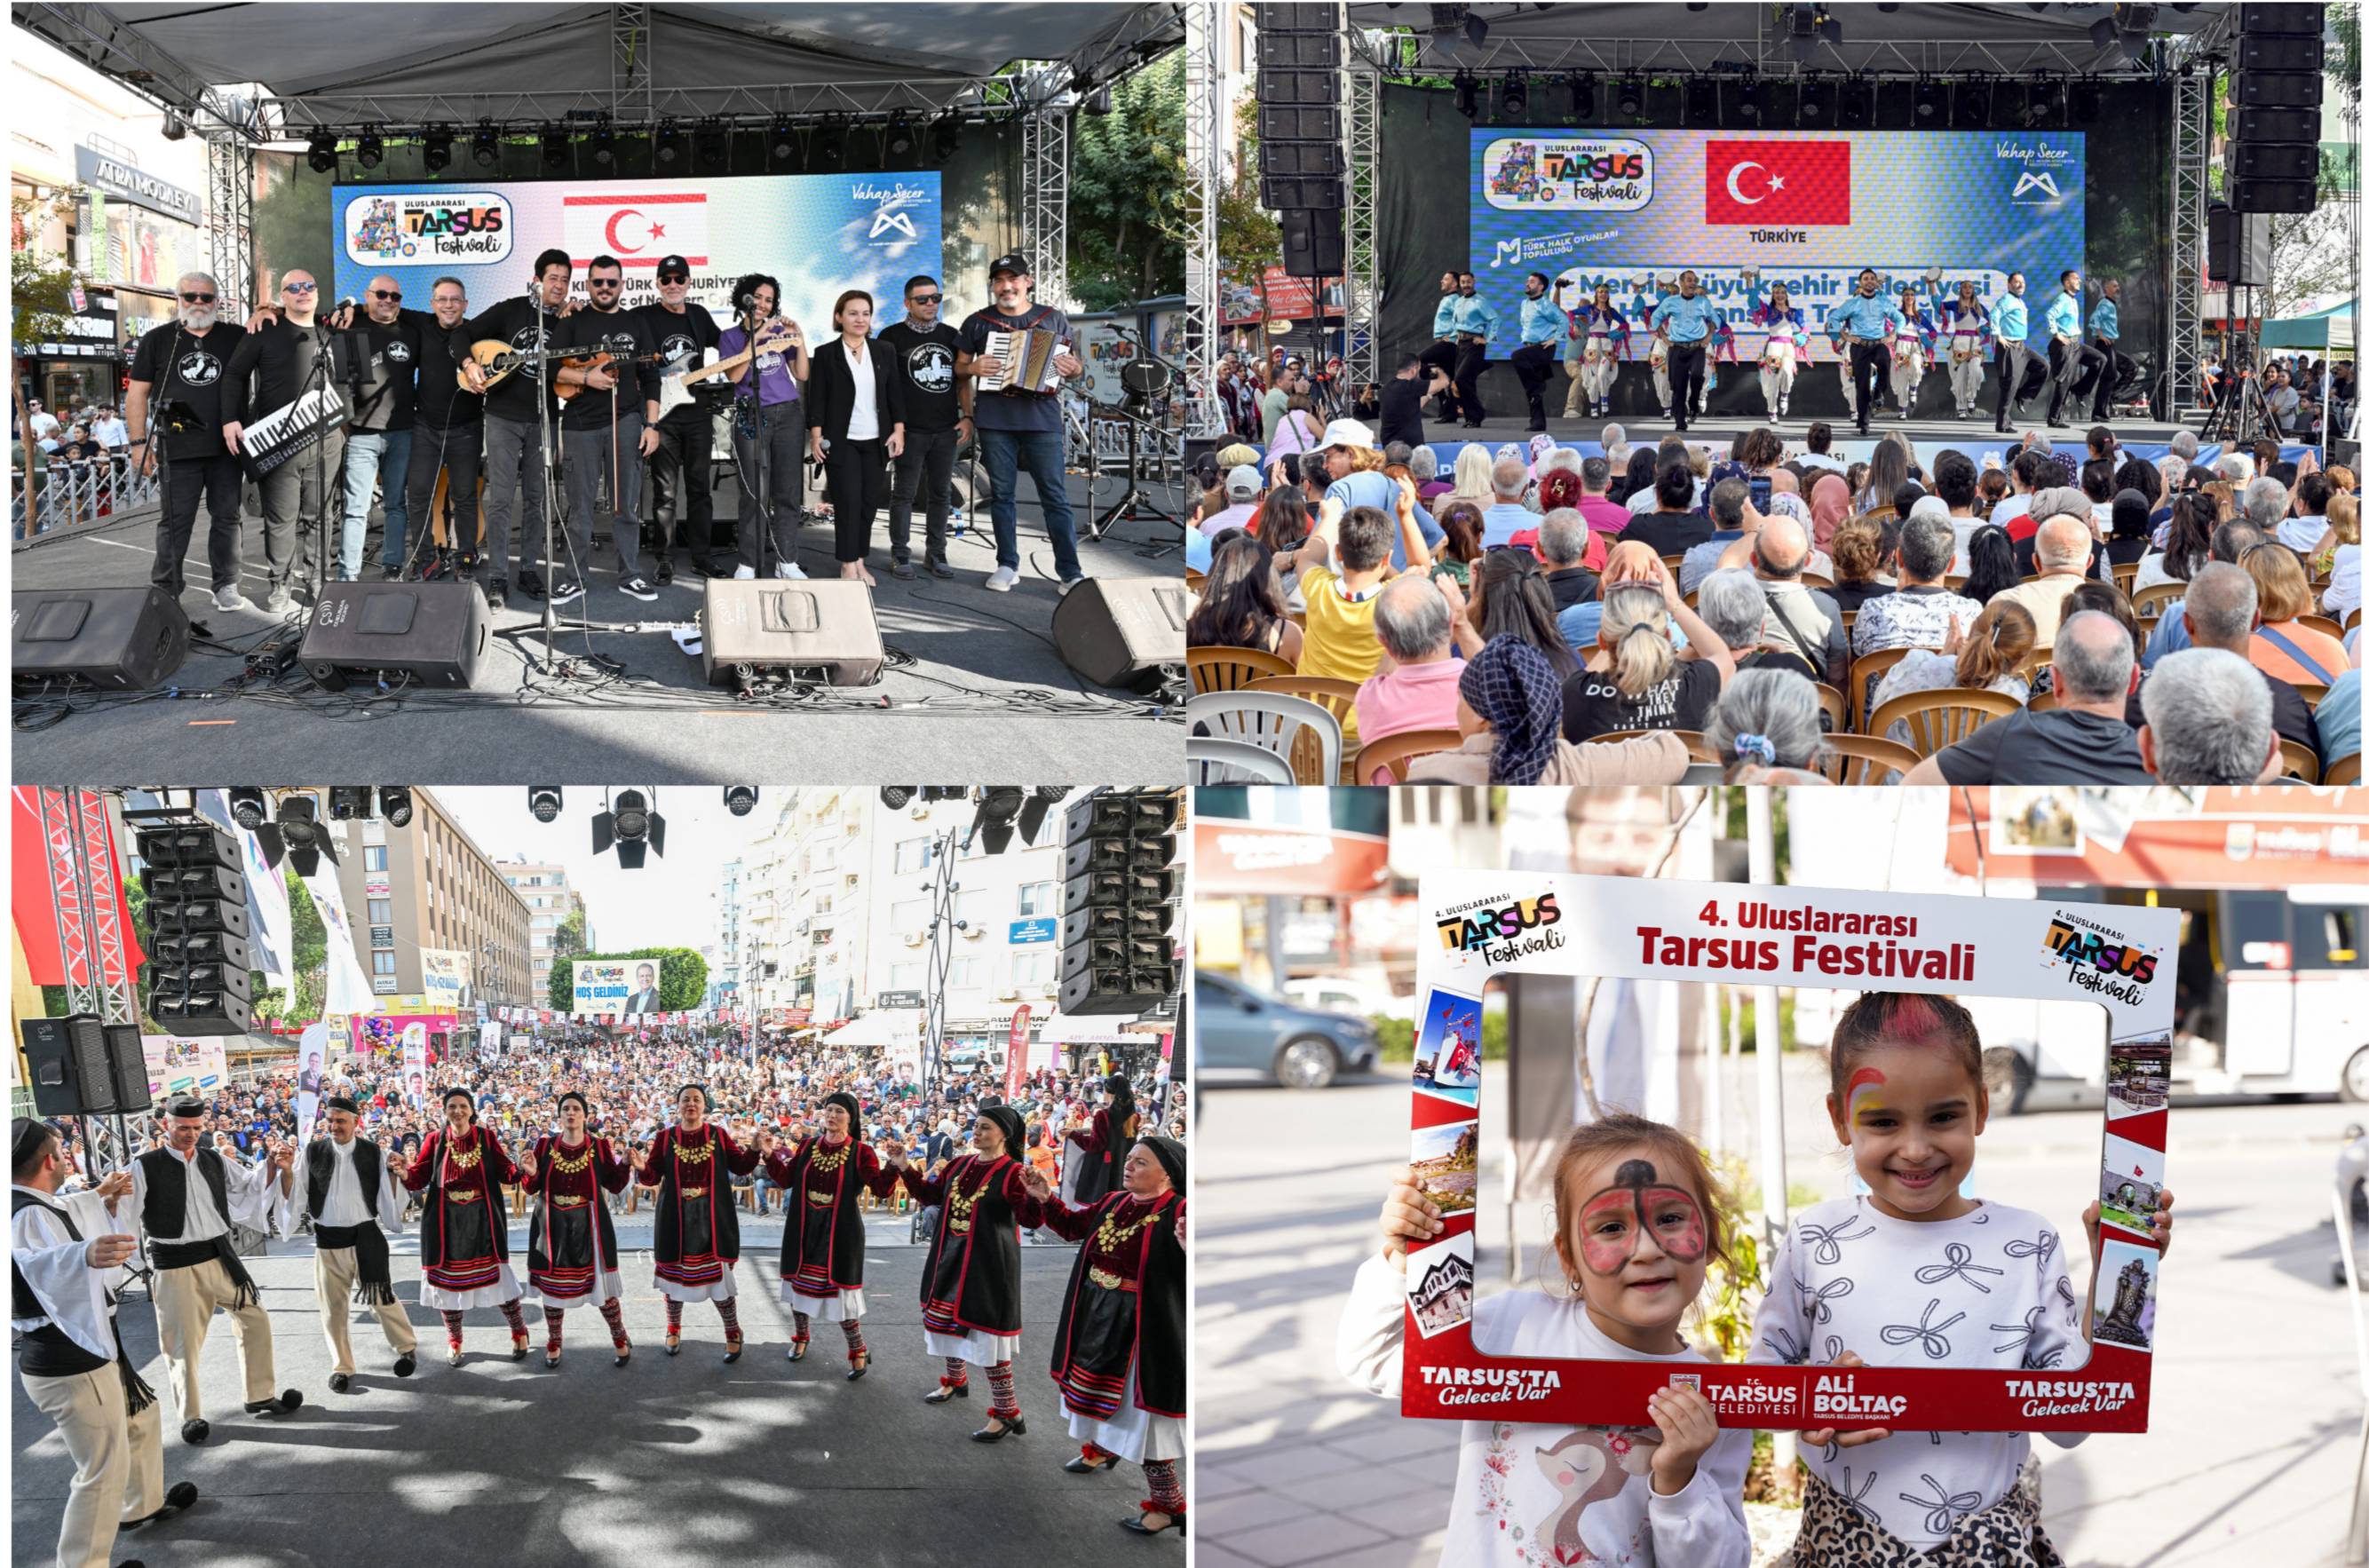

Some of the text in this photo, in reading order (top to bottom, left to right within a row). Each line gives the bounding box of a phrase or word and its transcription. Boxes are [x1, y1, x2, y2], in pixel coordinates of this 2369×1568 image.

[1997, 140, 2034, 165] Vahap
[1543, 154, 1644, 183] TARSUS
[852, 183, 891, 207] Vahap
[1573, 179, 1643, 202] Festivali
[404, 207, 503, 237] TARSUS
[434, 234, 503, 256] Festivali
[1523, 241, 1545, 252] TÜRK
[1548, 238, 1572, 249] HALK
[1573, 230, 1619, 244] OYUNLARI
[1749, 229, 1806, 243] TÜRKİYE
[1523, 245, 1573, 259] TOPLULUĞU
[622, 277, 653, 290] ÜRK
[630, 294, 644, 306] of
[1089, 341, 1133, 361] TARSUS
[1585, 684, 1617, 698] DO
[1649, 690, 1676, 705] THEY
[1637, 701, 1676, 718] THINK
[1446, 893, 1511, 915] ULUSLARARASI
[1437, 892, 1561, 952] TARSUS
[1699, 899, 1918, 938] 4. Uluslararası
[2065, 913, 2125, 940] ULUSLARARASI
[1482, 929, 1565, 967] Festivali
[1636, 926, 1976, 981] Tarsus Festivali
[2044, 918, 2159, 985] TARSUS
[595, 968, 624, 978] TARSUS
[2068, 960, 2144, 1007] Festivali
[575, 983, 629, 1001] HOŞ GELDİNİZ
[1420, 1366, 1561, 1388] TARSUS'TA
[1814, 1374, 1855, 1393] ALİ
[1438, 1382, 1551, 1406] Gelecek Var
[1707, 1384, 1797, 1403] TARSUS
[2005, 1380, 2135, 1399] TARSUS'TA
[1710, 1403, 1796, 1414] BELEDİYESİ
[1814, 1395, 1908, 1416] BOLTAÇ
[2022, 1394, 2126, 1418] Gelecek Var
